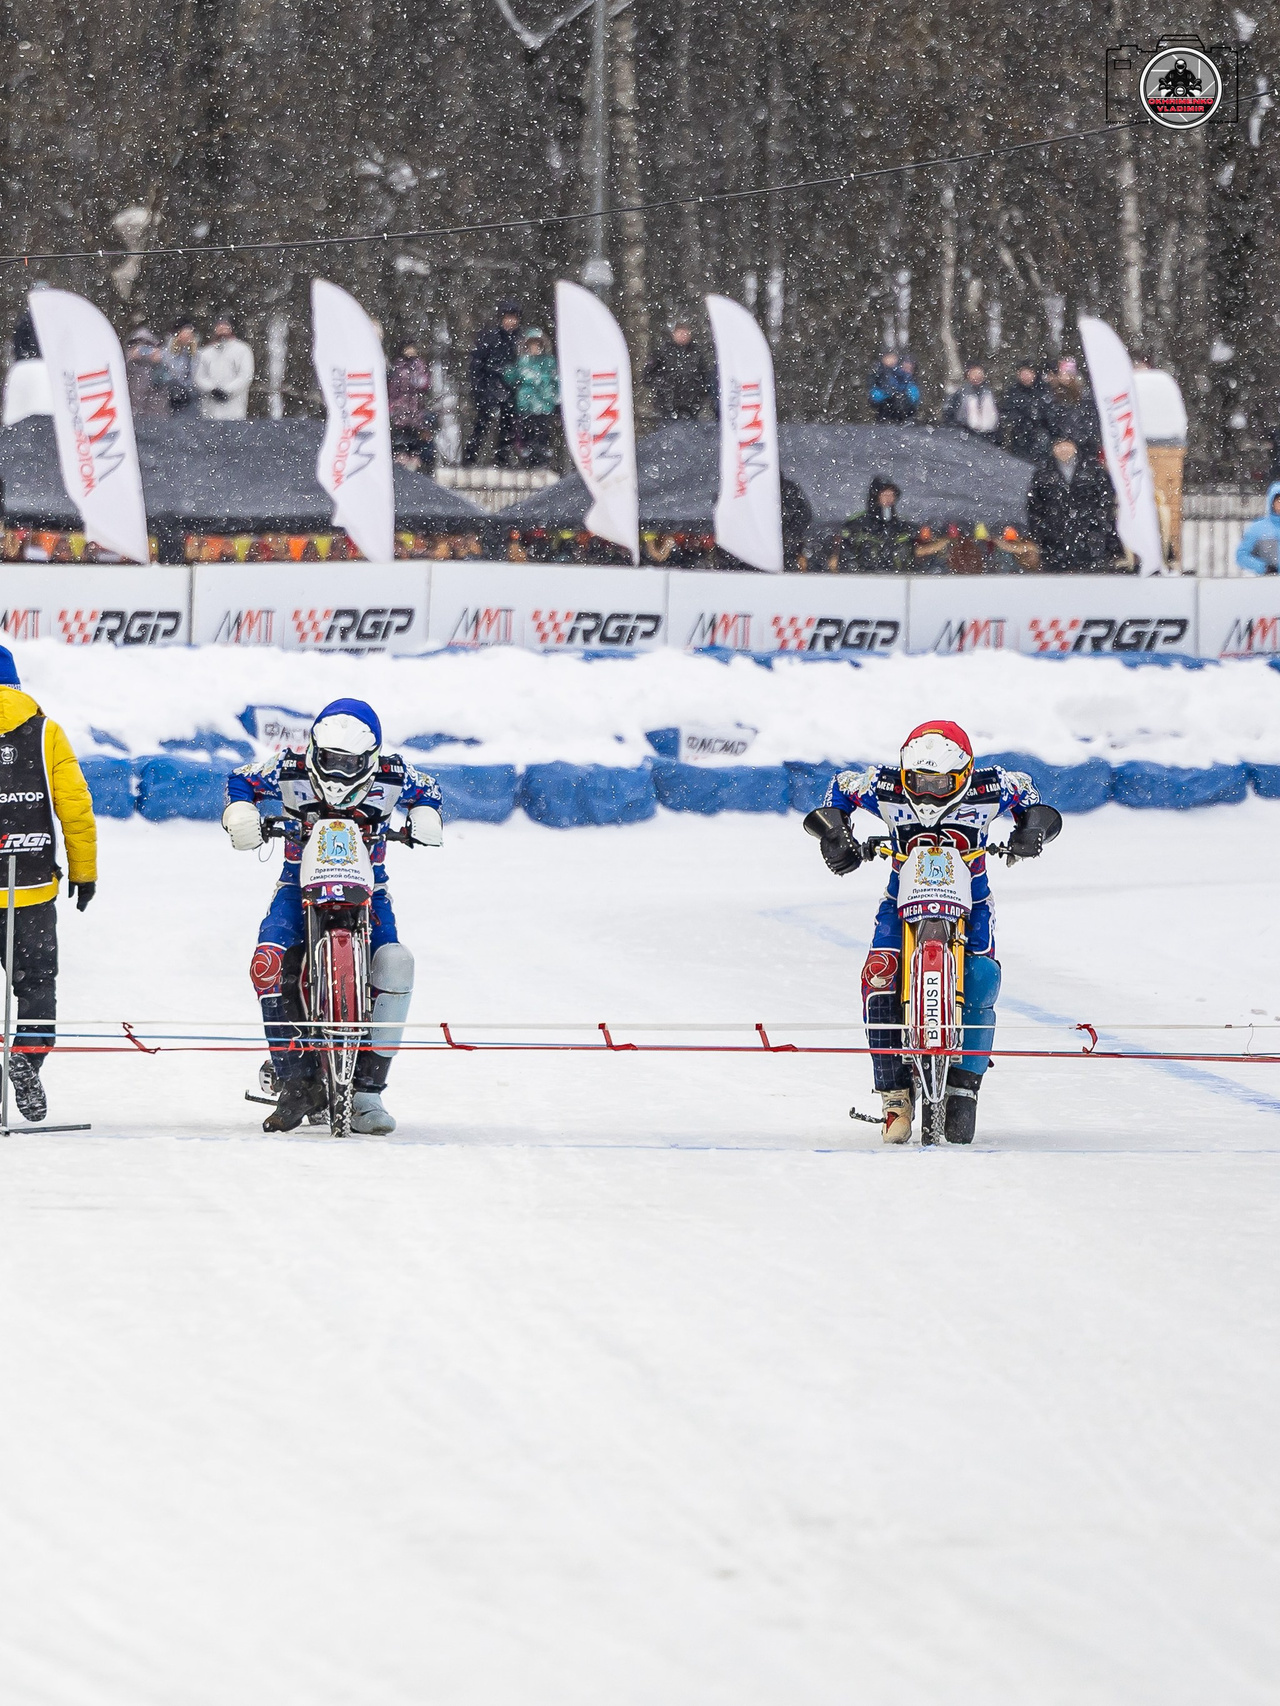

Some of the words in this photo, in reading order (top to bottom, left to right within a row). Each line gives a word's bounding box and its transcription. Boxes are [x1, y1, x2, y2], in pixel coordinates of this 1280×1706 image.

[93, 610, 182, 645] RGP
[325, 608, 415, 642] RGP
[450, 607, 516, 641] MMT
[566, 611, 664, 646] RGP
[807, 617, 901, 651] RGP
[1071, 618, 1189, 651] RGP
[1222, 616, 1280, 651] MM
[876, 780, 894, 792] MEGA
[4, 833, 52, 848] RGP
[309, 873, 343, 881] Самарской
[314, 867, 361, 875] Правительство
[939, 894, 962, 902] области
[902, 904, 923, 919] MEGA
